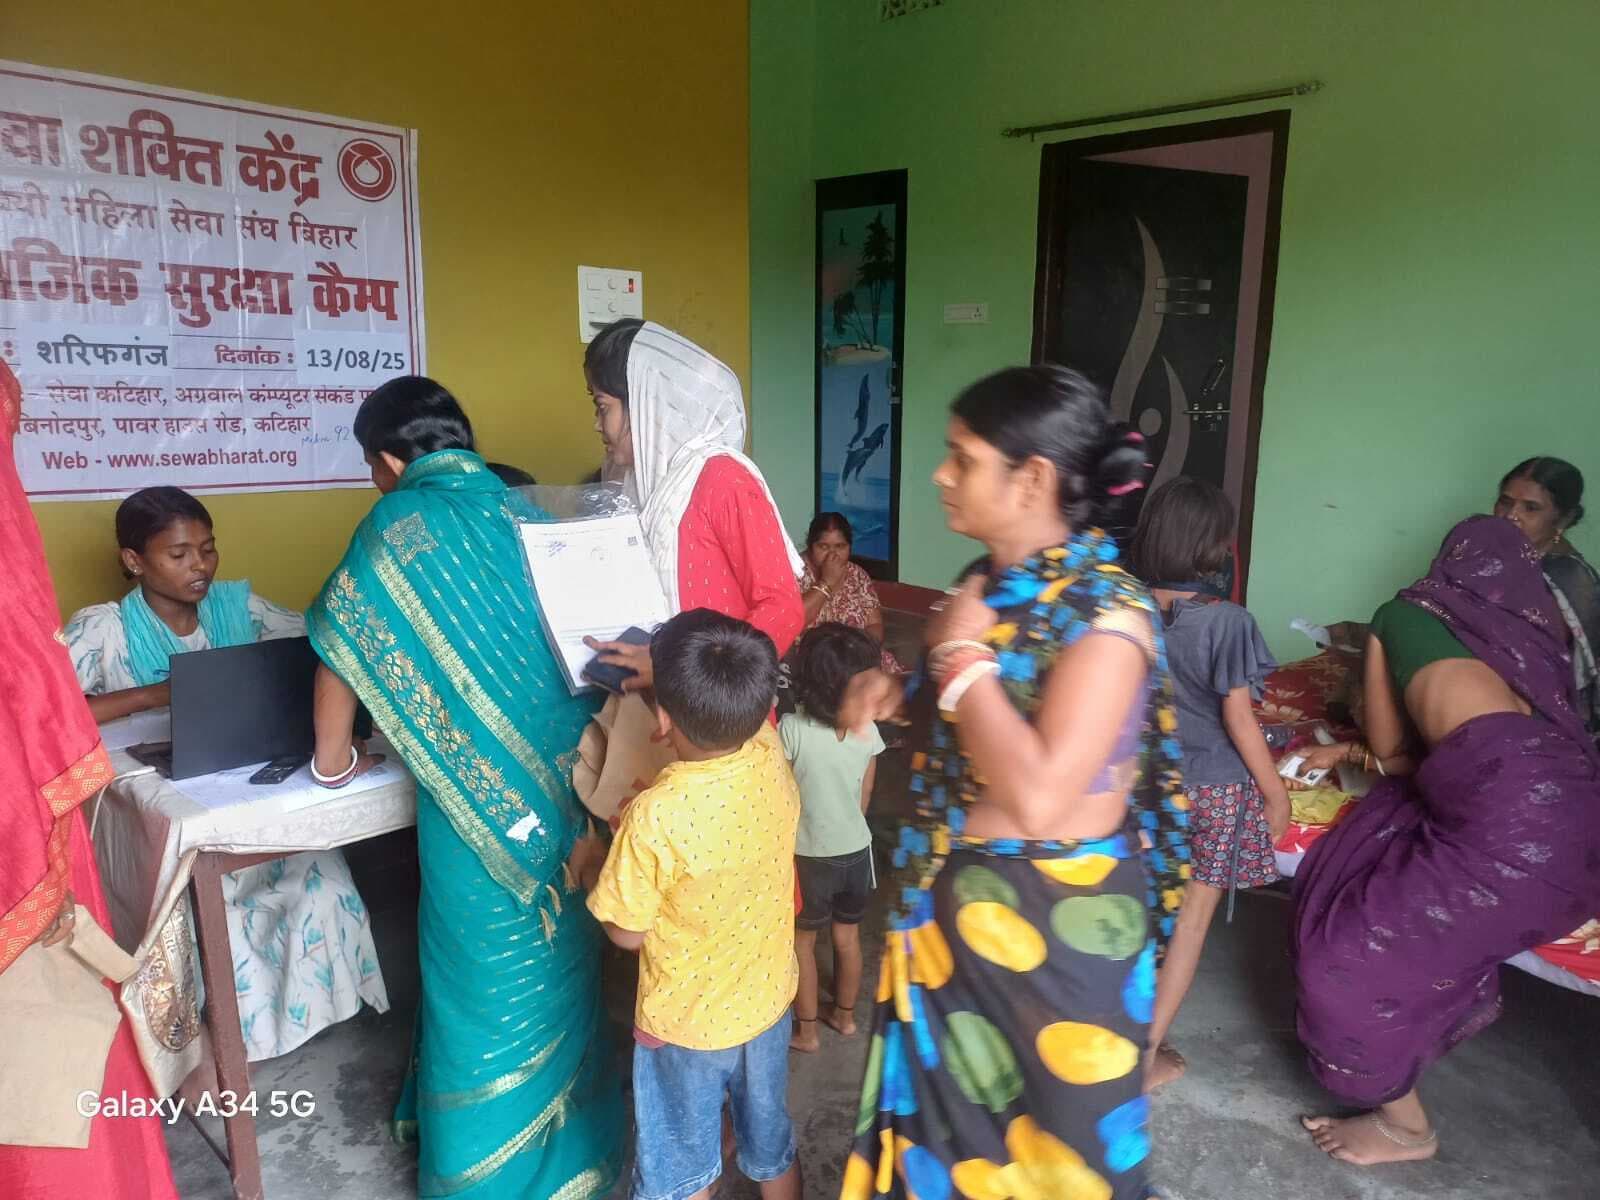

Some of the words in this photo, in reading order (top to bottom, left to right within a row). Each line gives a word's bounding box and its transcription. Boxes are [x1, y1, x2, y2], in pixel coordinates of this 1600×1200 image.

[0, 110, 63, 168] वा
[79, 108, 224, 187] शक्ति
[235, 129, 323, 207] केंद्र
[61, 188, 158, 230] महिला
[167, 198, 225, 238] सेवा
[234, 210, 279, 243] संघ
[287, 211, 358, 251] बिहार
[0, 237, 142, 306] ाजिक
[158, 262, 294, 328] सुरक्षा
[308, 261, 400, 321] कैम्प
[36, 334, 169, 367] शरिफगंज
[213, 344, 282, 365] दिनांक
[306, 347, 406, 373] 13/08/25
[93, 380, 168, 407] कटिहार,
[175, 387, 243, 404] अग्रवाल
[112, 417, 161, 434] पावर
[213, 411, 247, 435] रोड,
[252, 411, 312, 435] कटिहार
[42, 450, 89, 470] Web
[107, 447, 298, 468] www.sewabharat.org
